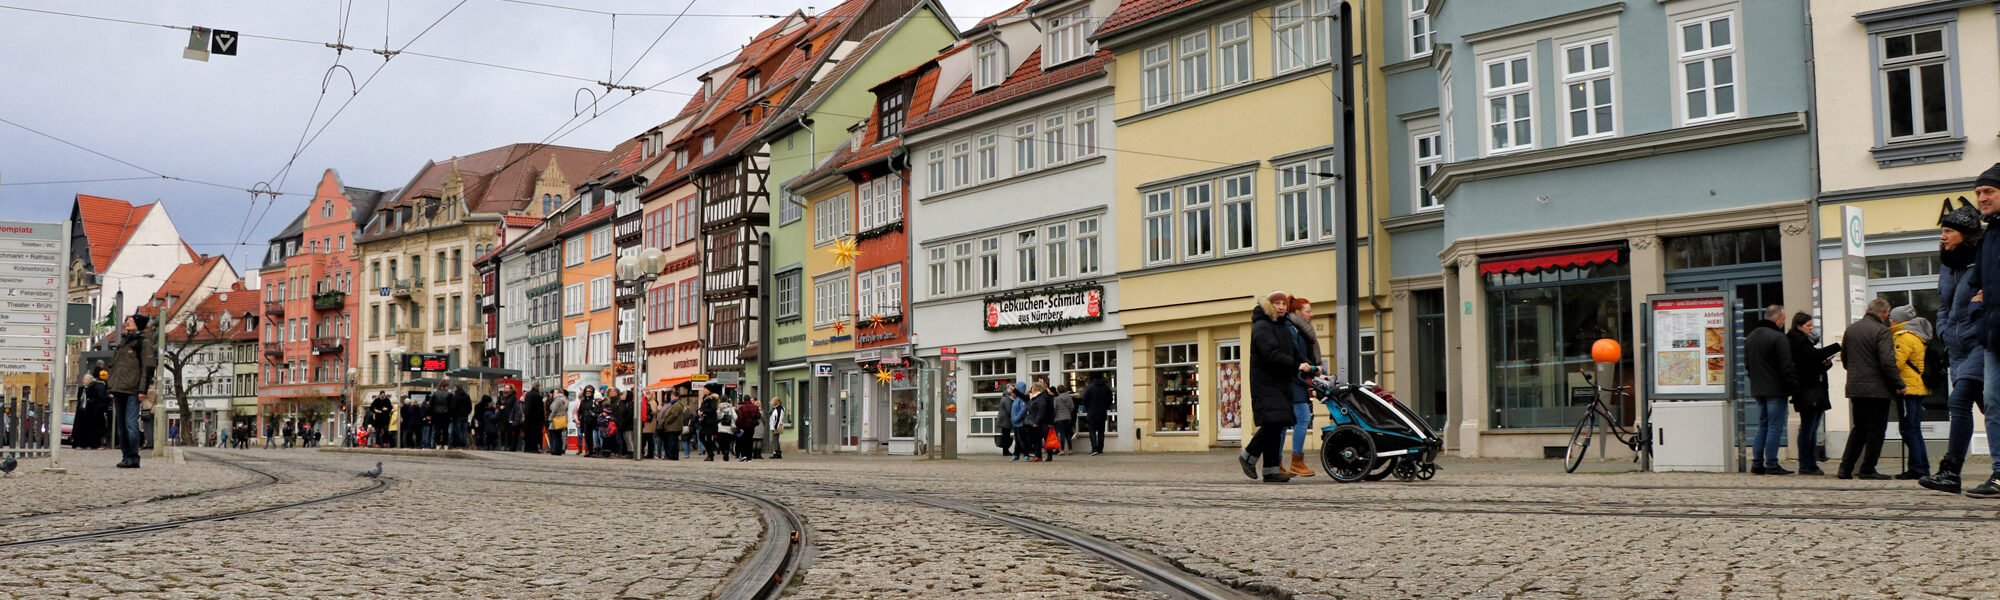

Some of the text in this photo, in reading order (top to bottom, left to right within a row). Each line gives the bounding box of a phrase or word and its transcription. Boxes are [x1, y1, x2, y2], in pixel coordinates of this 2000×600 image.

[1000, 292, 1085, 313] Lebkuchen-Schmidt
[1018, 309, 1064, 323] aus Nürnberg
